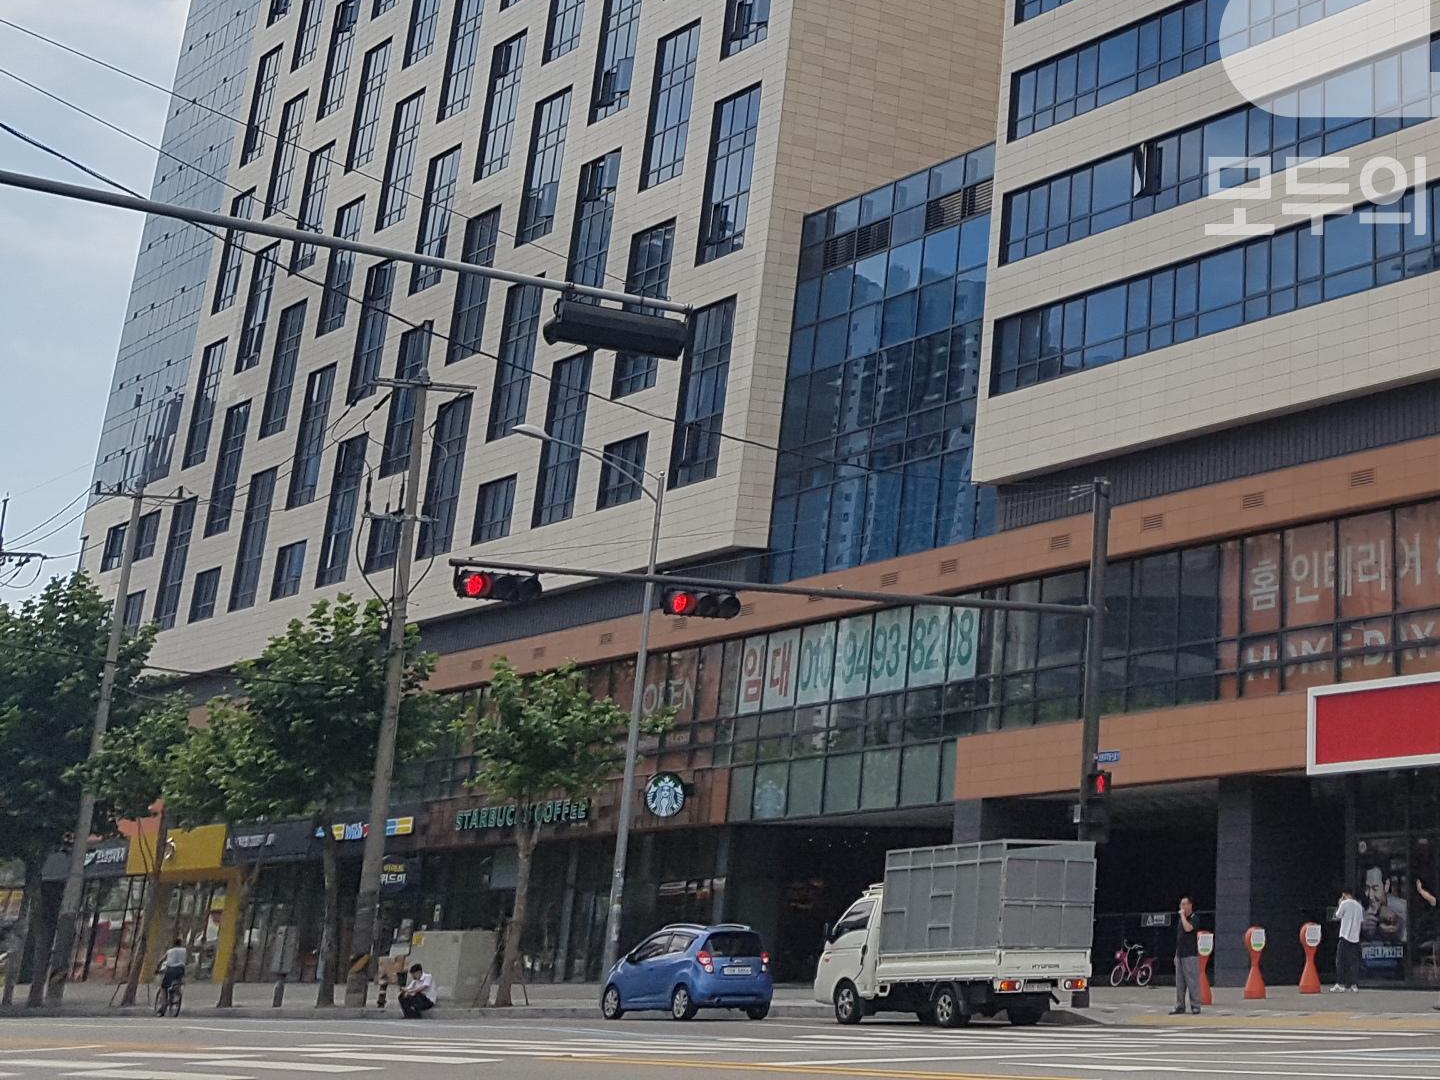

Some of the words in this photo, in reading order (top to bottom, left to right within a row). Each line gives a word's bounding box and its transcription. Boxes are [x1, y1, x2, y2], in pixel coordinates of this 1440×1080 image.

[1249, 559, 1280, 612] 홈
[1291, 532, 1422, 605] 인테리어
[743, 639, 794, 703] 임대
[800, 609, 975, 692] 010-9493-8208
